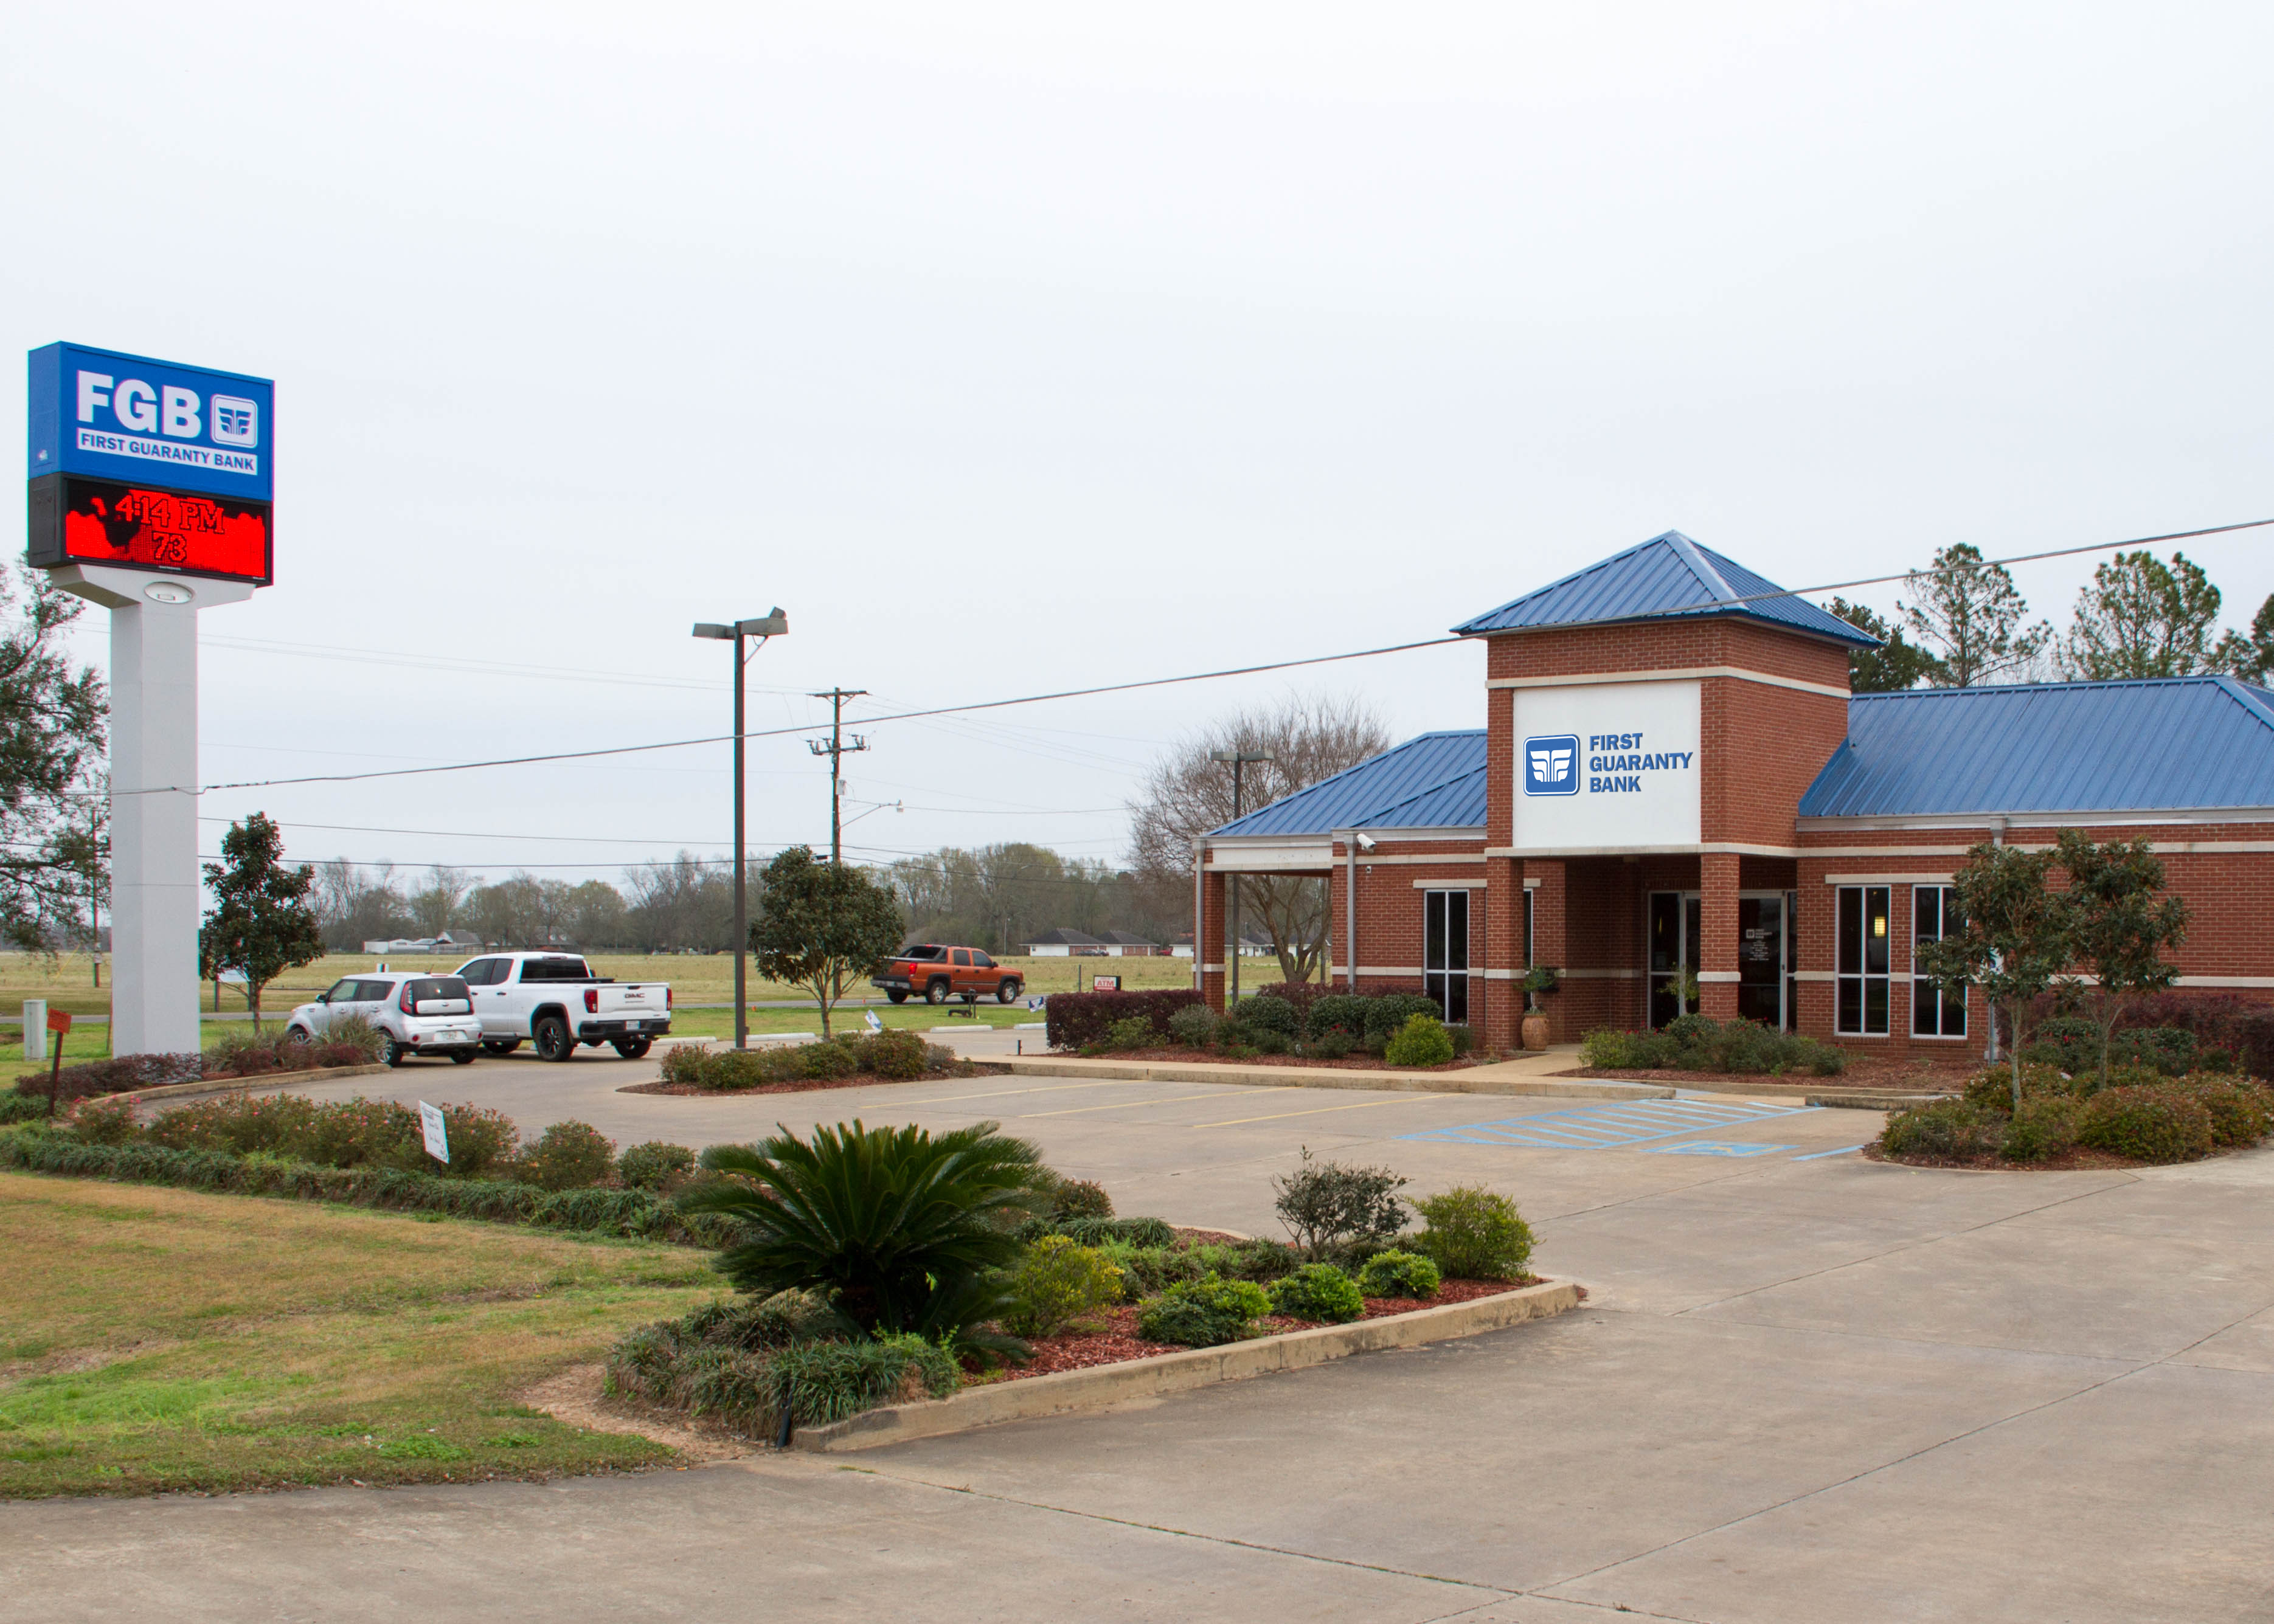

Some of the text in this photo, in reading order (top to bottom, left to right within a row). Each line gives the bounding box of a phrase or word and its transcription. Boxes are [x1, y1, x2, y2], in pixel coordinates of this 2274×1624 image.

[78, 370, 202, 438] FGB
[81, 433, 254, 471] FIRST GUARANTY BANK
[115, 494, 224, 534] 4:14 PM
[152, 531, 186, 562] 73
[1589, 733, 1643, 752] FIRST
[1589, 752, 1693, 772] GUARANTY
[1589, 776, 1641, 793] BANK
